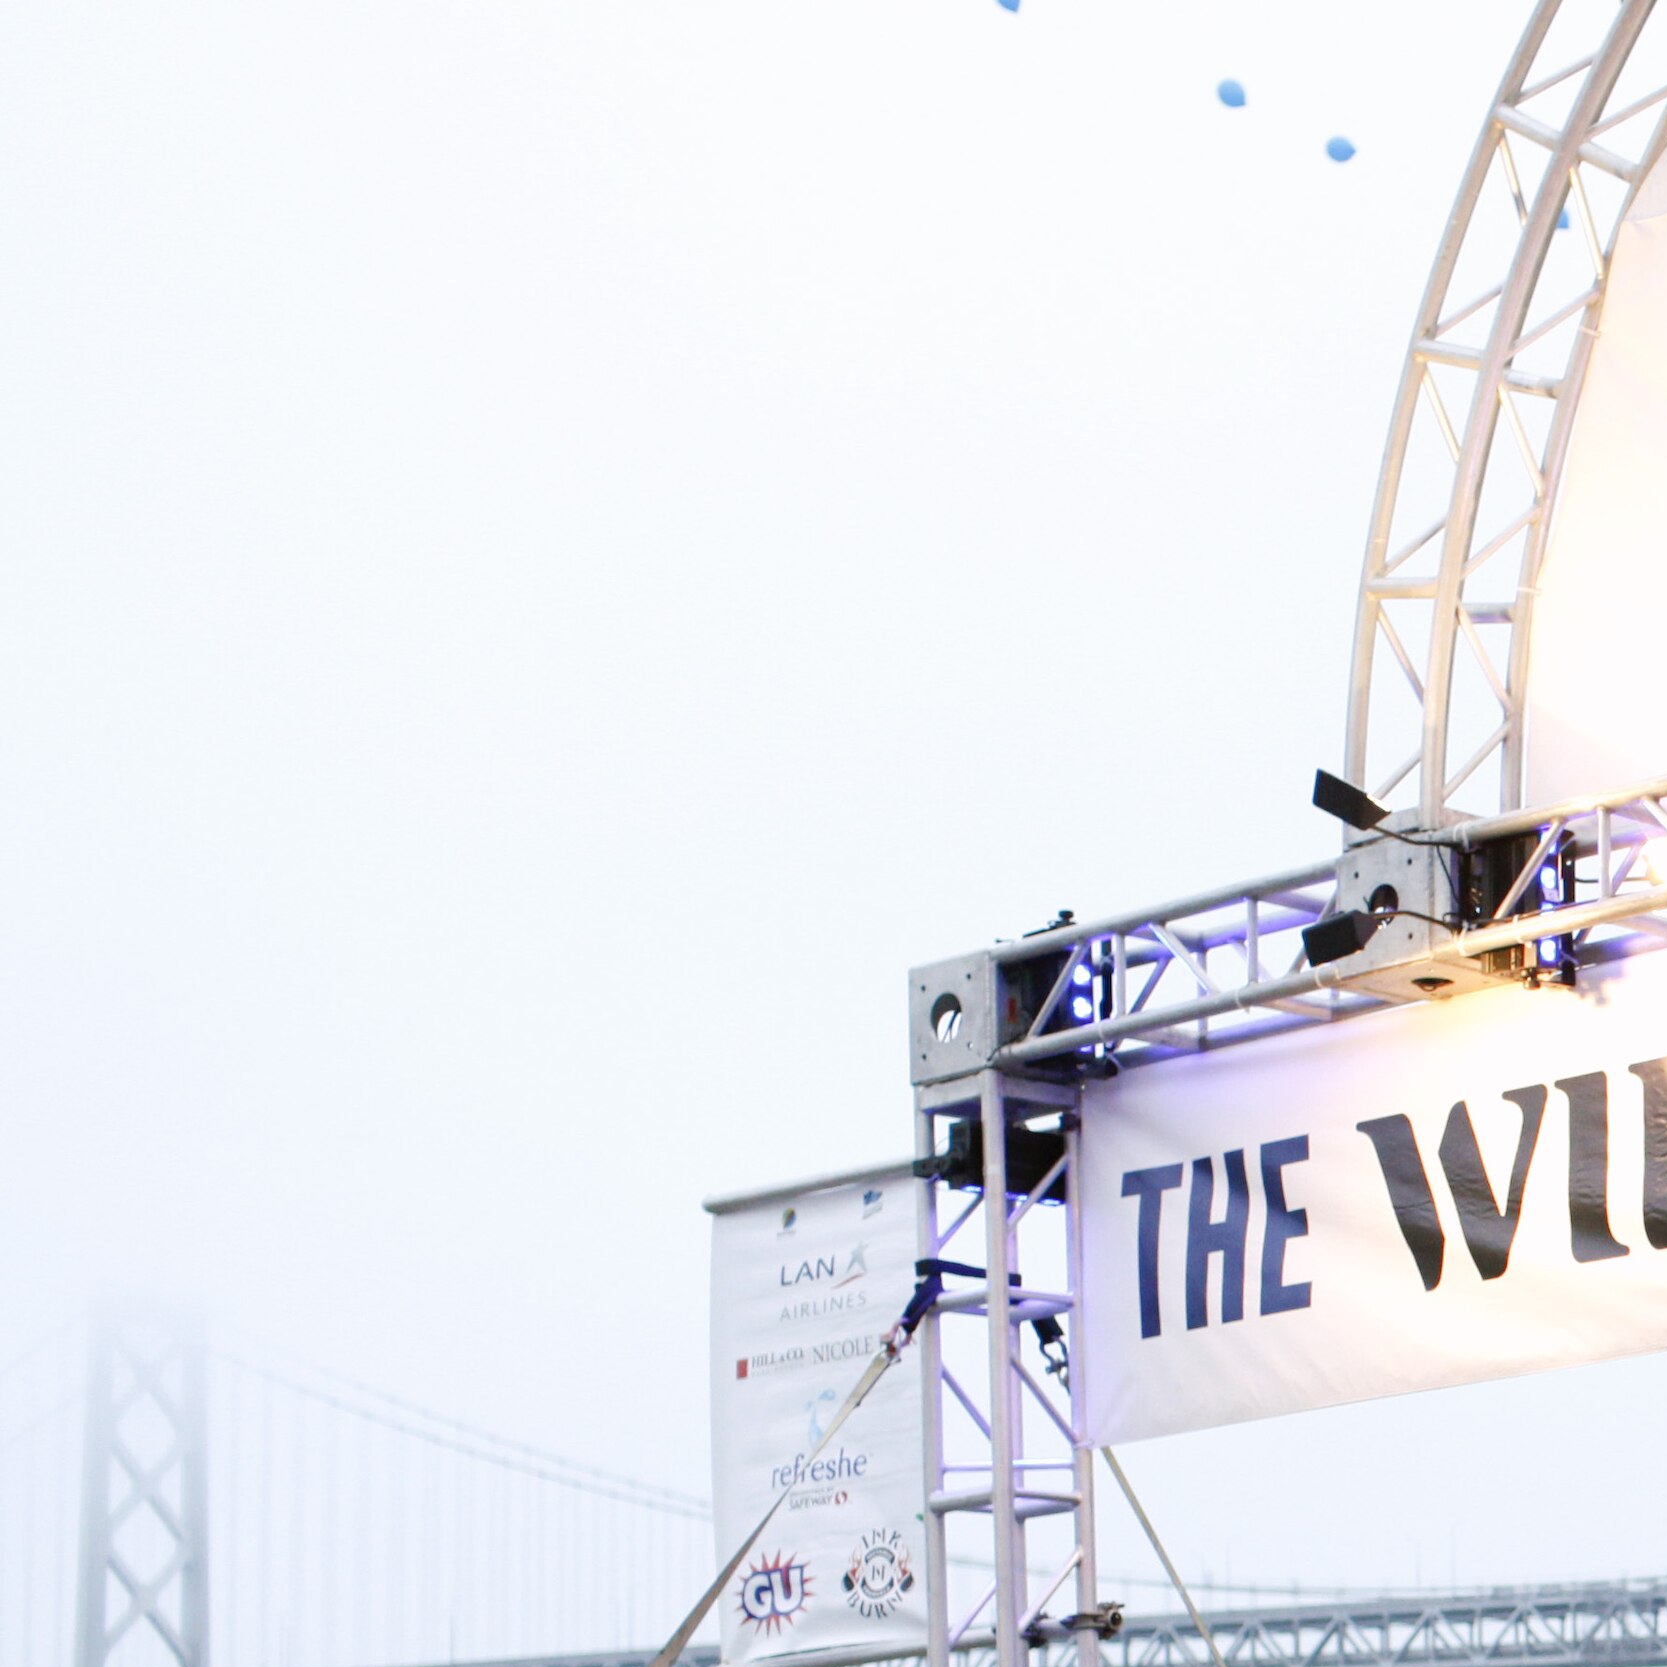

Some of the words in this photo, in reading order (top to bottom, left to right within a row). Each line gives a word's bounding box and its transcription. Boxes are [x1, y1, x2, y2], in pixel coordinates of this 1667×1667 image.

[1120, 1133, 1312, 1340] THE
[780, 1255, 835, 1287] LAN
[779, 1291, 867, 1322] AIRLINES
[812, 1336, 874, 1364] NICOLE
[772, 1447, 868, 1489] refreshe
[743, 1564, 805, 1621] GU
